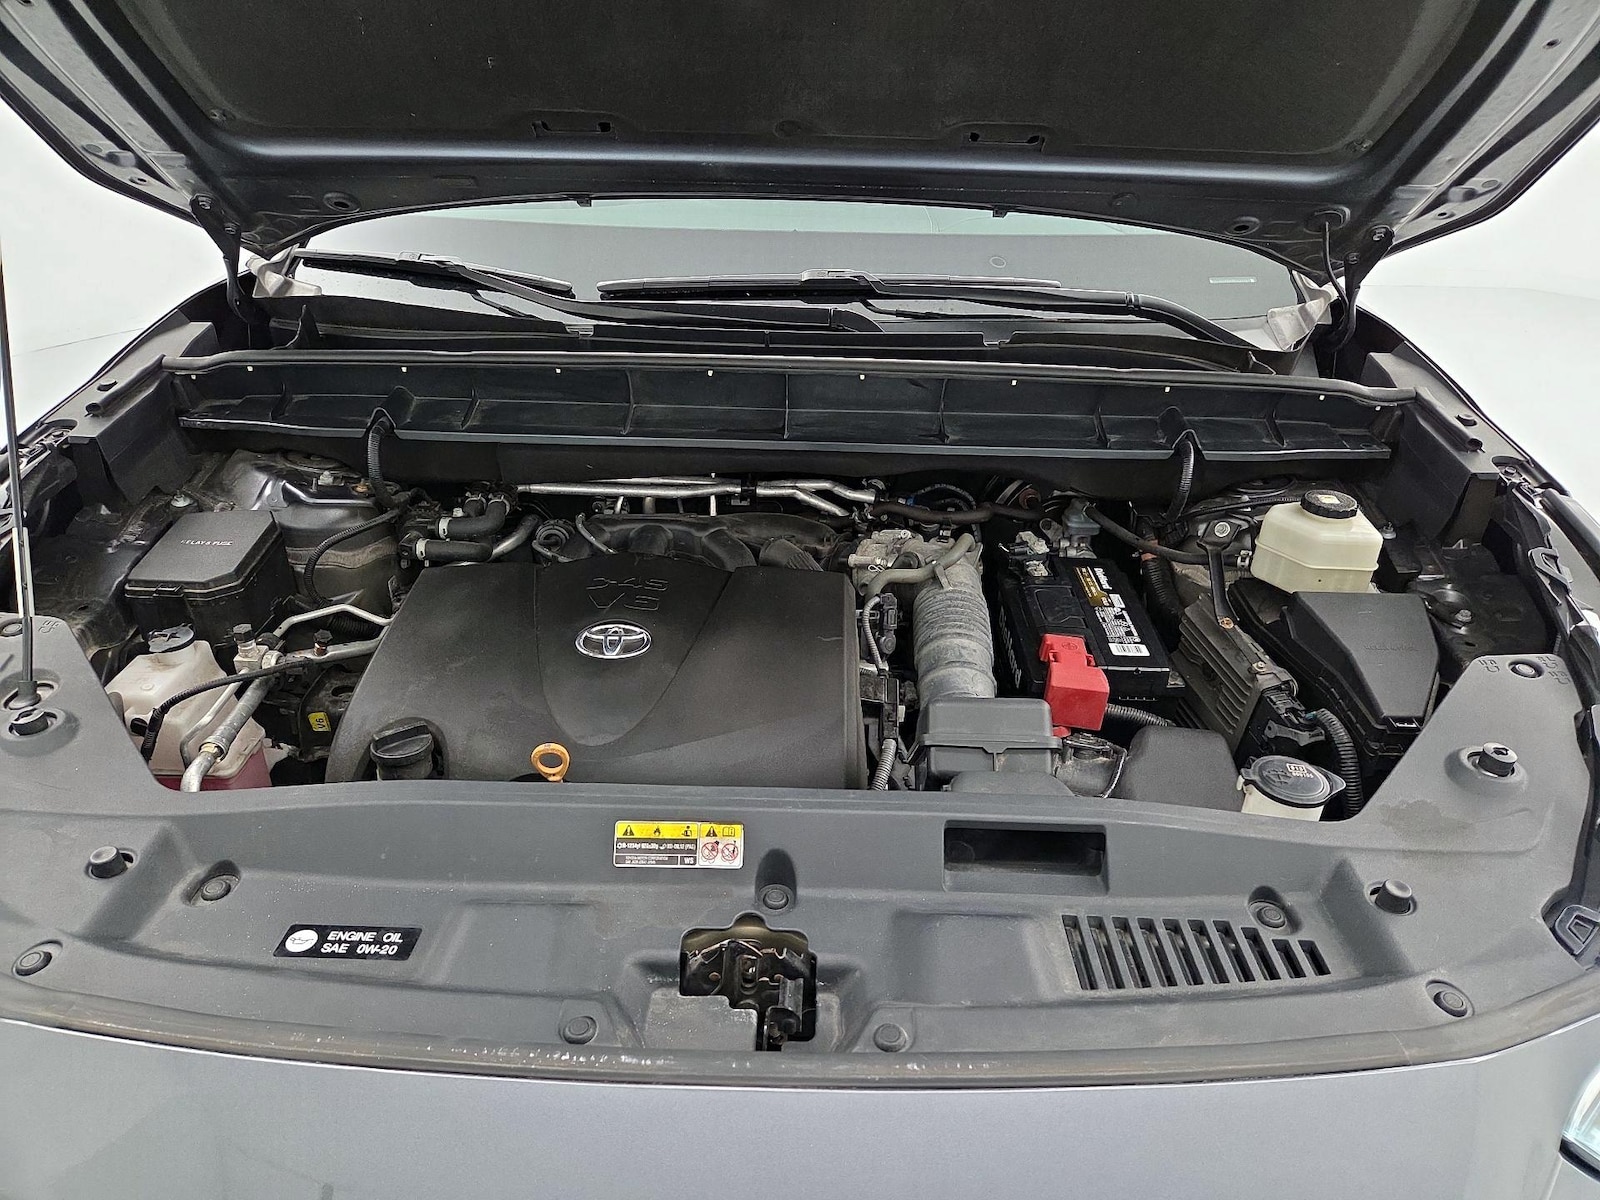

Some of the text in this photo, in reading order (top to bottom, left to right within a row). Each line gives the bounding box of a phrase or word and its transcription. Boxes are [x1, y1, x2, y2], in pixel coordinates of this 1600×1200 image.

[683, 857, 695, 865] WS
[327, 930, 403, 943] ENGINE OIL
[320, 942, 398, 955] SAE 0W-20
